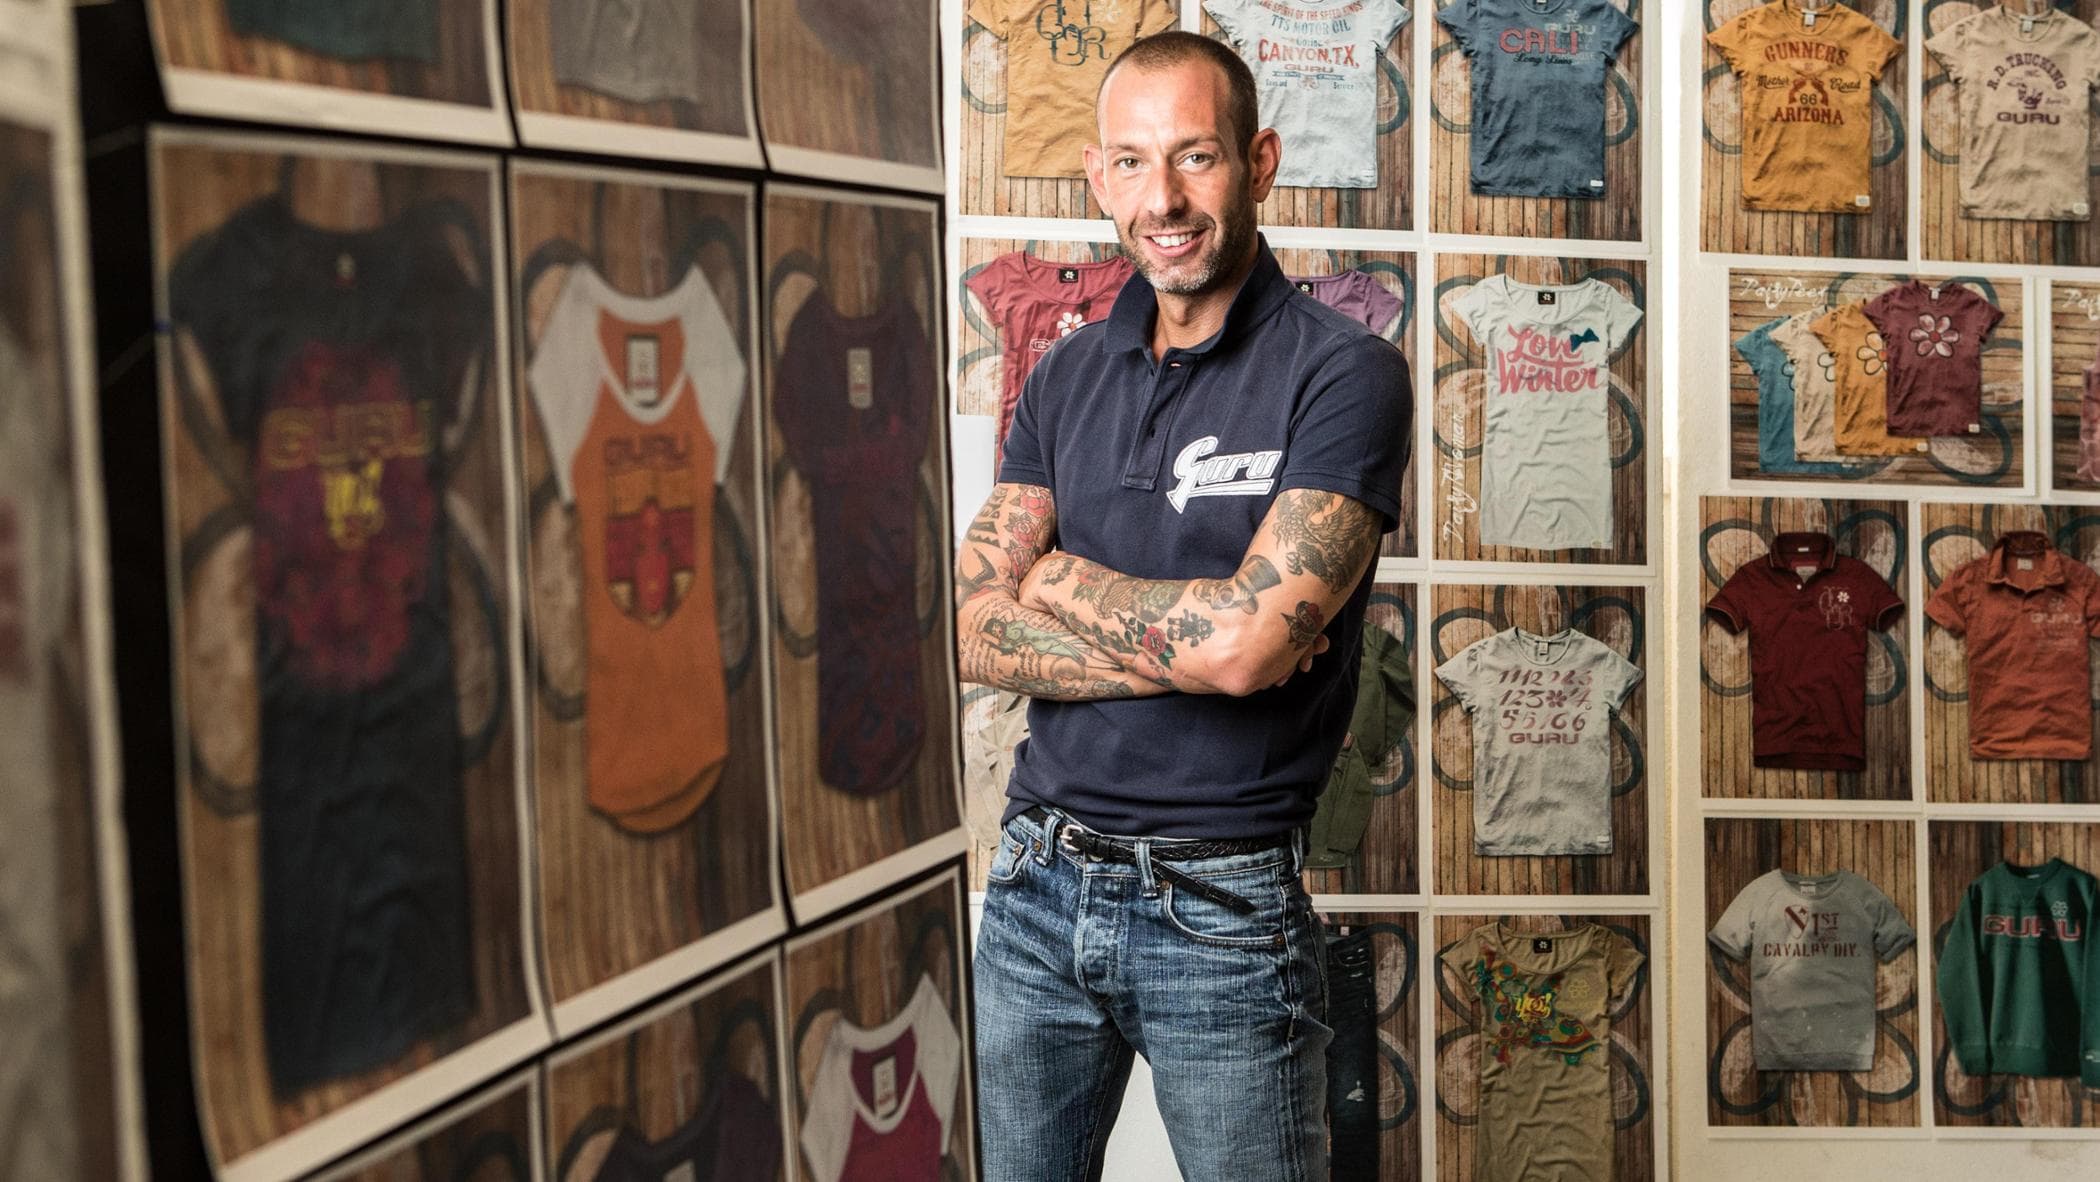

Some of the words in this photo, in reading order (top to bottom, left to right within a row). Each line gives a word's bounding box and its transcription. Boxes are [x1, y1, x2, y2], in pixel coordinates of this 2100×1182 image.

[1293, 21, 1329, 35] MOTOR
[1332, 18, 1351, 33] OIL
[1499, 26, 1578, 55] CALI
[1764, 41, 1849, 66] GUNNERS
[1284, 63, 1334, 73] GURU
[1799, 93, 1817, 105] 66
[1773, 106, 1845, 125] ARIZONA
[1997, 112, 2060, 125] GURU
[1497, 348, 1600, 396] Winter
[1166, 436, 1282, 514] Guru
[1509, 733, 1579, 745] GURU
[1983, 914, 2081, 941] GURU
